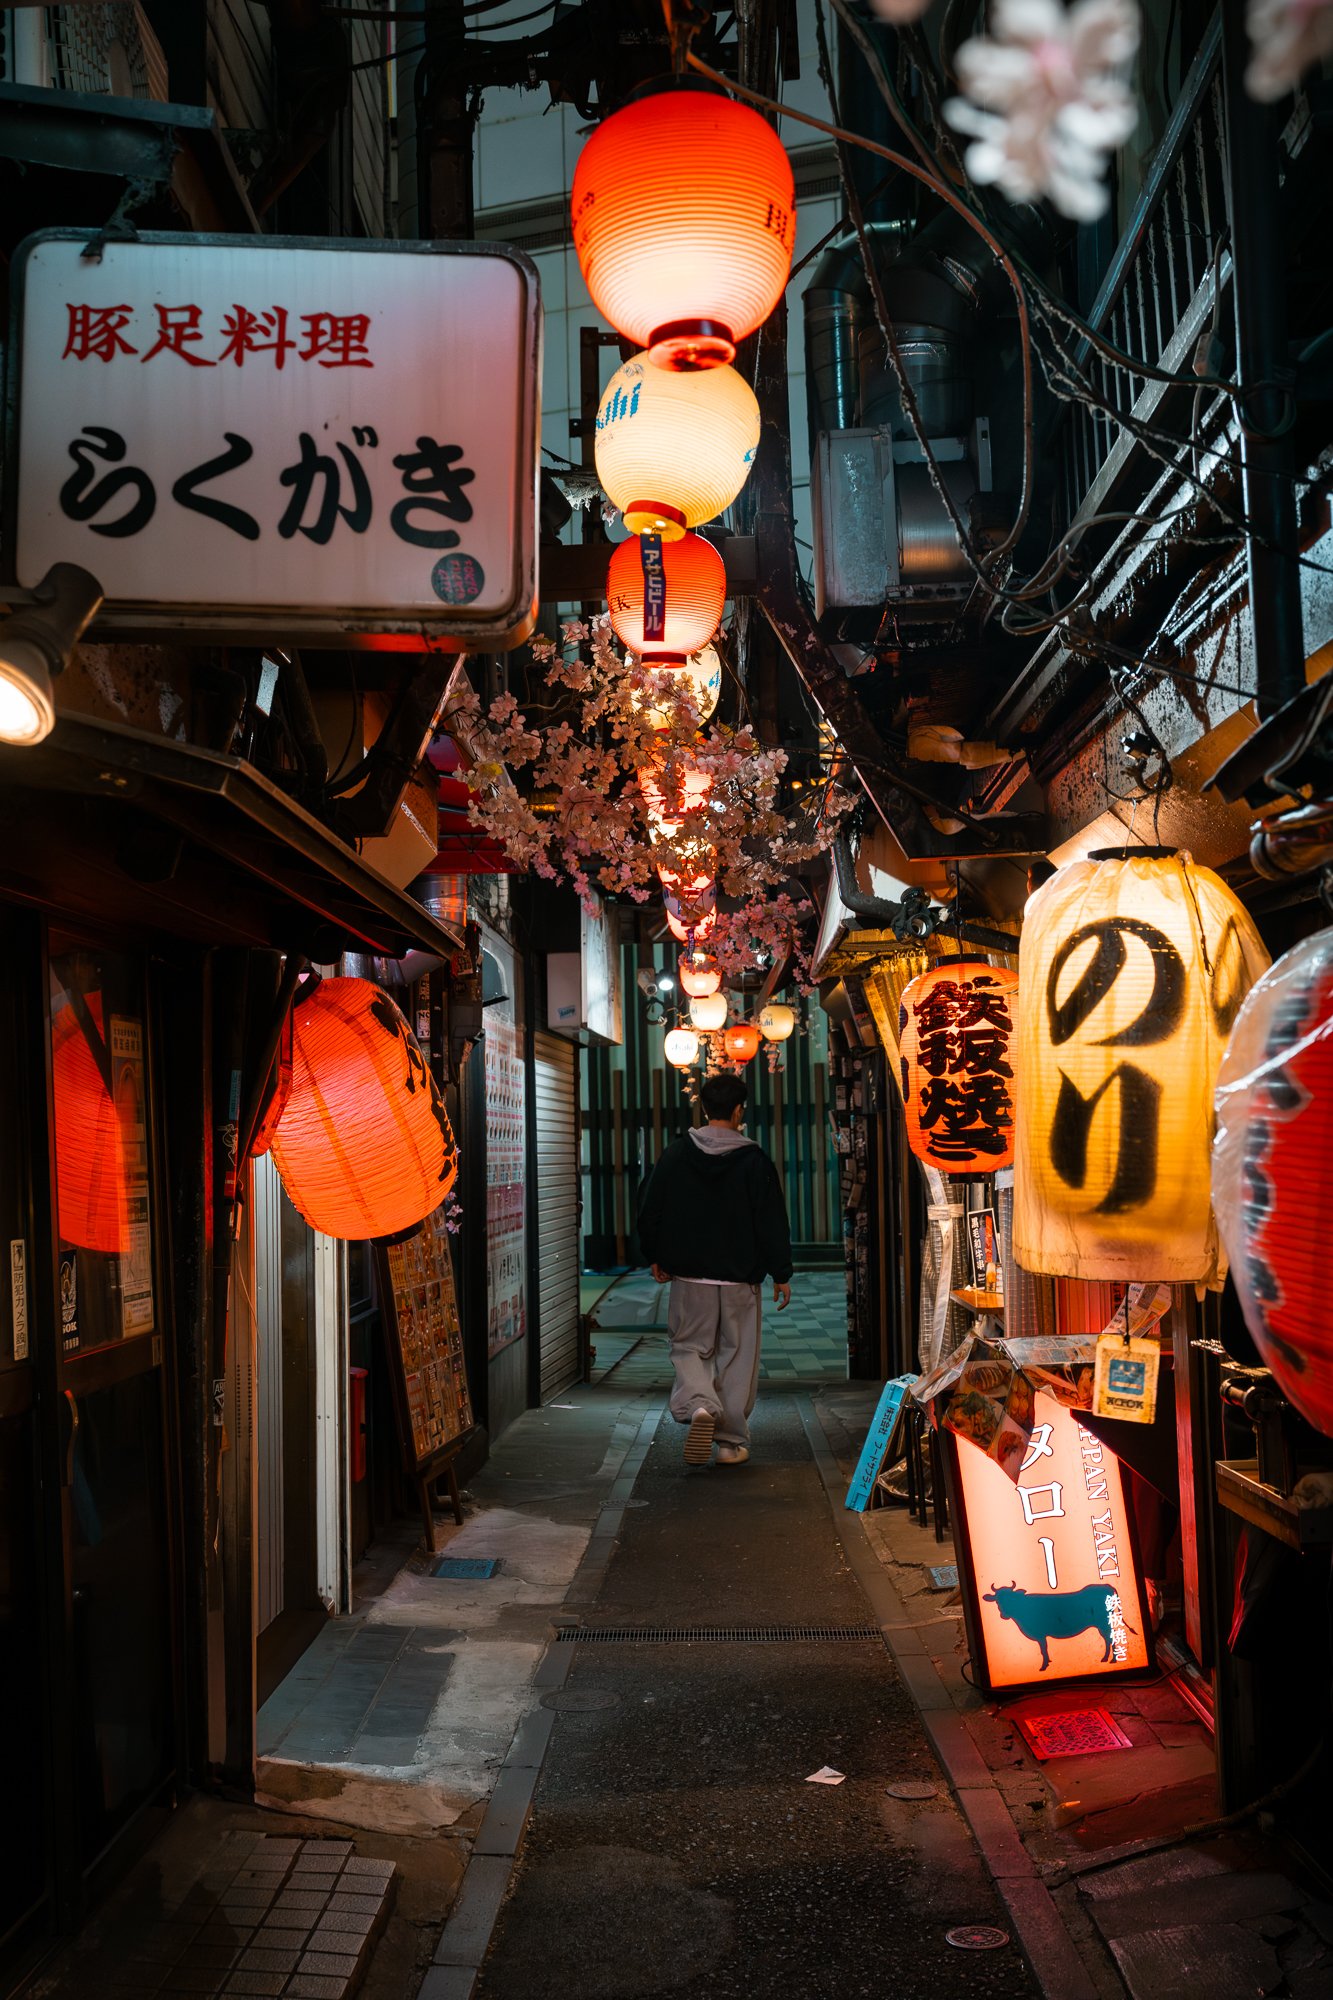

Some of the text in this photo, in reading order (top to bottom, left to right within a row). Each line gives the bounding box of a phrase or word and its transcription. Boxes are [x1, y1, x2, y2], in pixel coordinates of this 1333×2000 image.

[61, 303, 374, 370] 豚足料理
[59, 426, 476, 549] らくがき
[1046, 916, 1187, 1215] のり
[1091, 1508, 1120, 1579] YAKI
[1105, 1593, 1128, 1662] 鉄板焼き
